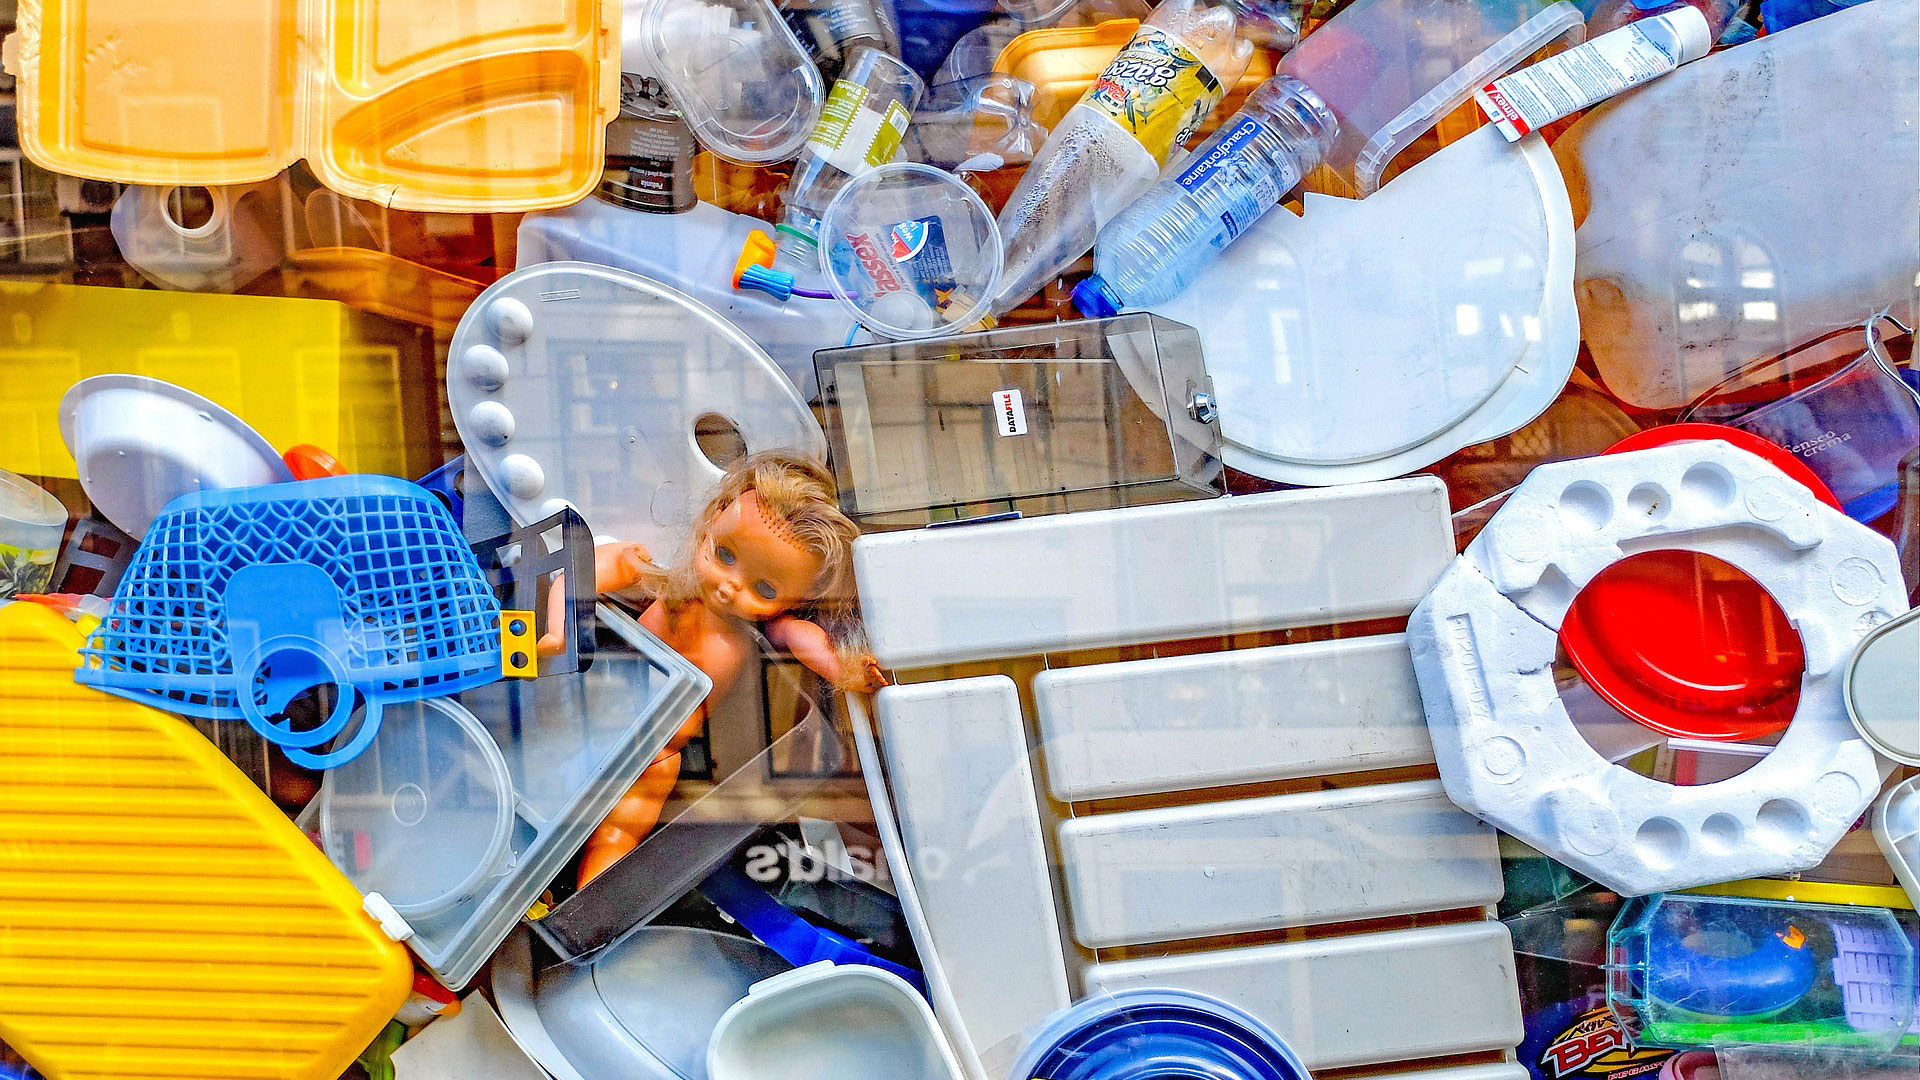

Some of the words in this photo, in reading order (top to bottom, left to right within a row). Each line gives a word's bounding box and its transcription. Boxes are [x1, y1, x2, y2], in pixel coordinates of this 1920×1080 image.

[1493, 91, 1519, 121] elmex
[1182, 121, 1256, 186] Chaudfontaine
[1002, 393, 1017, 433] DATAFILE
[1803, 432, 1853, 457] crema
